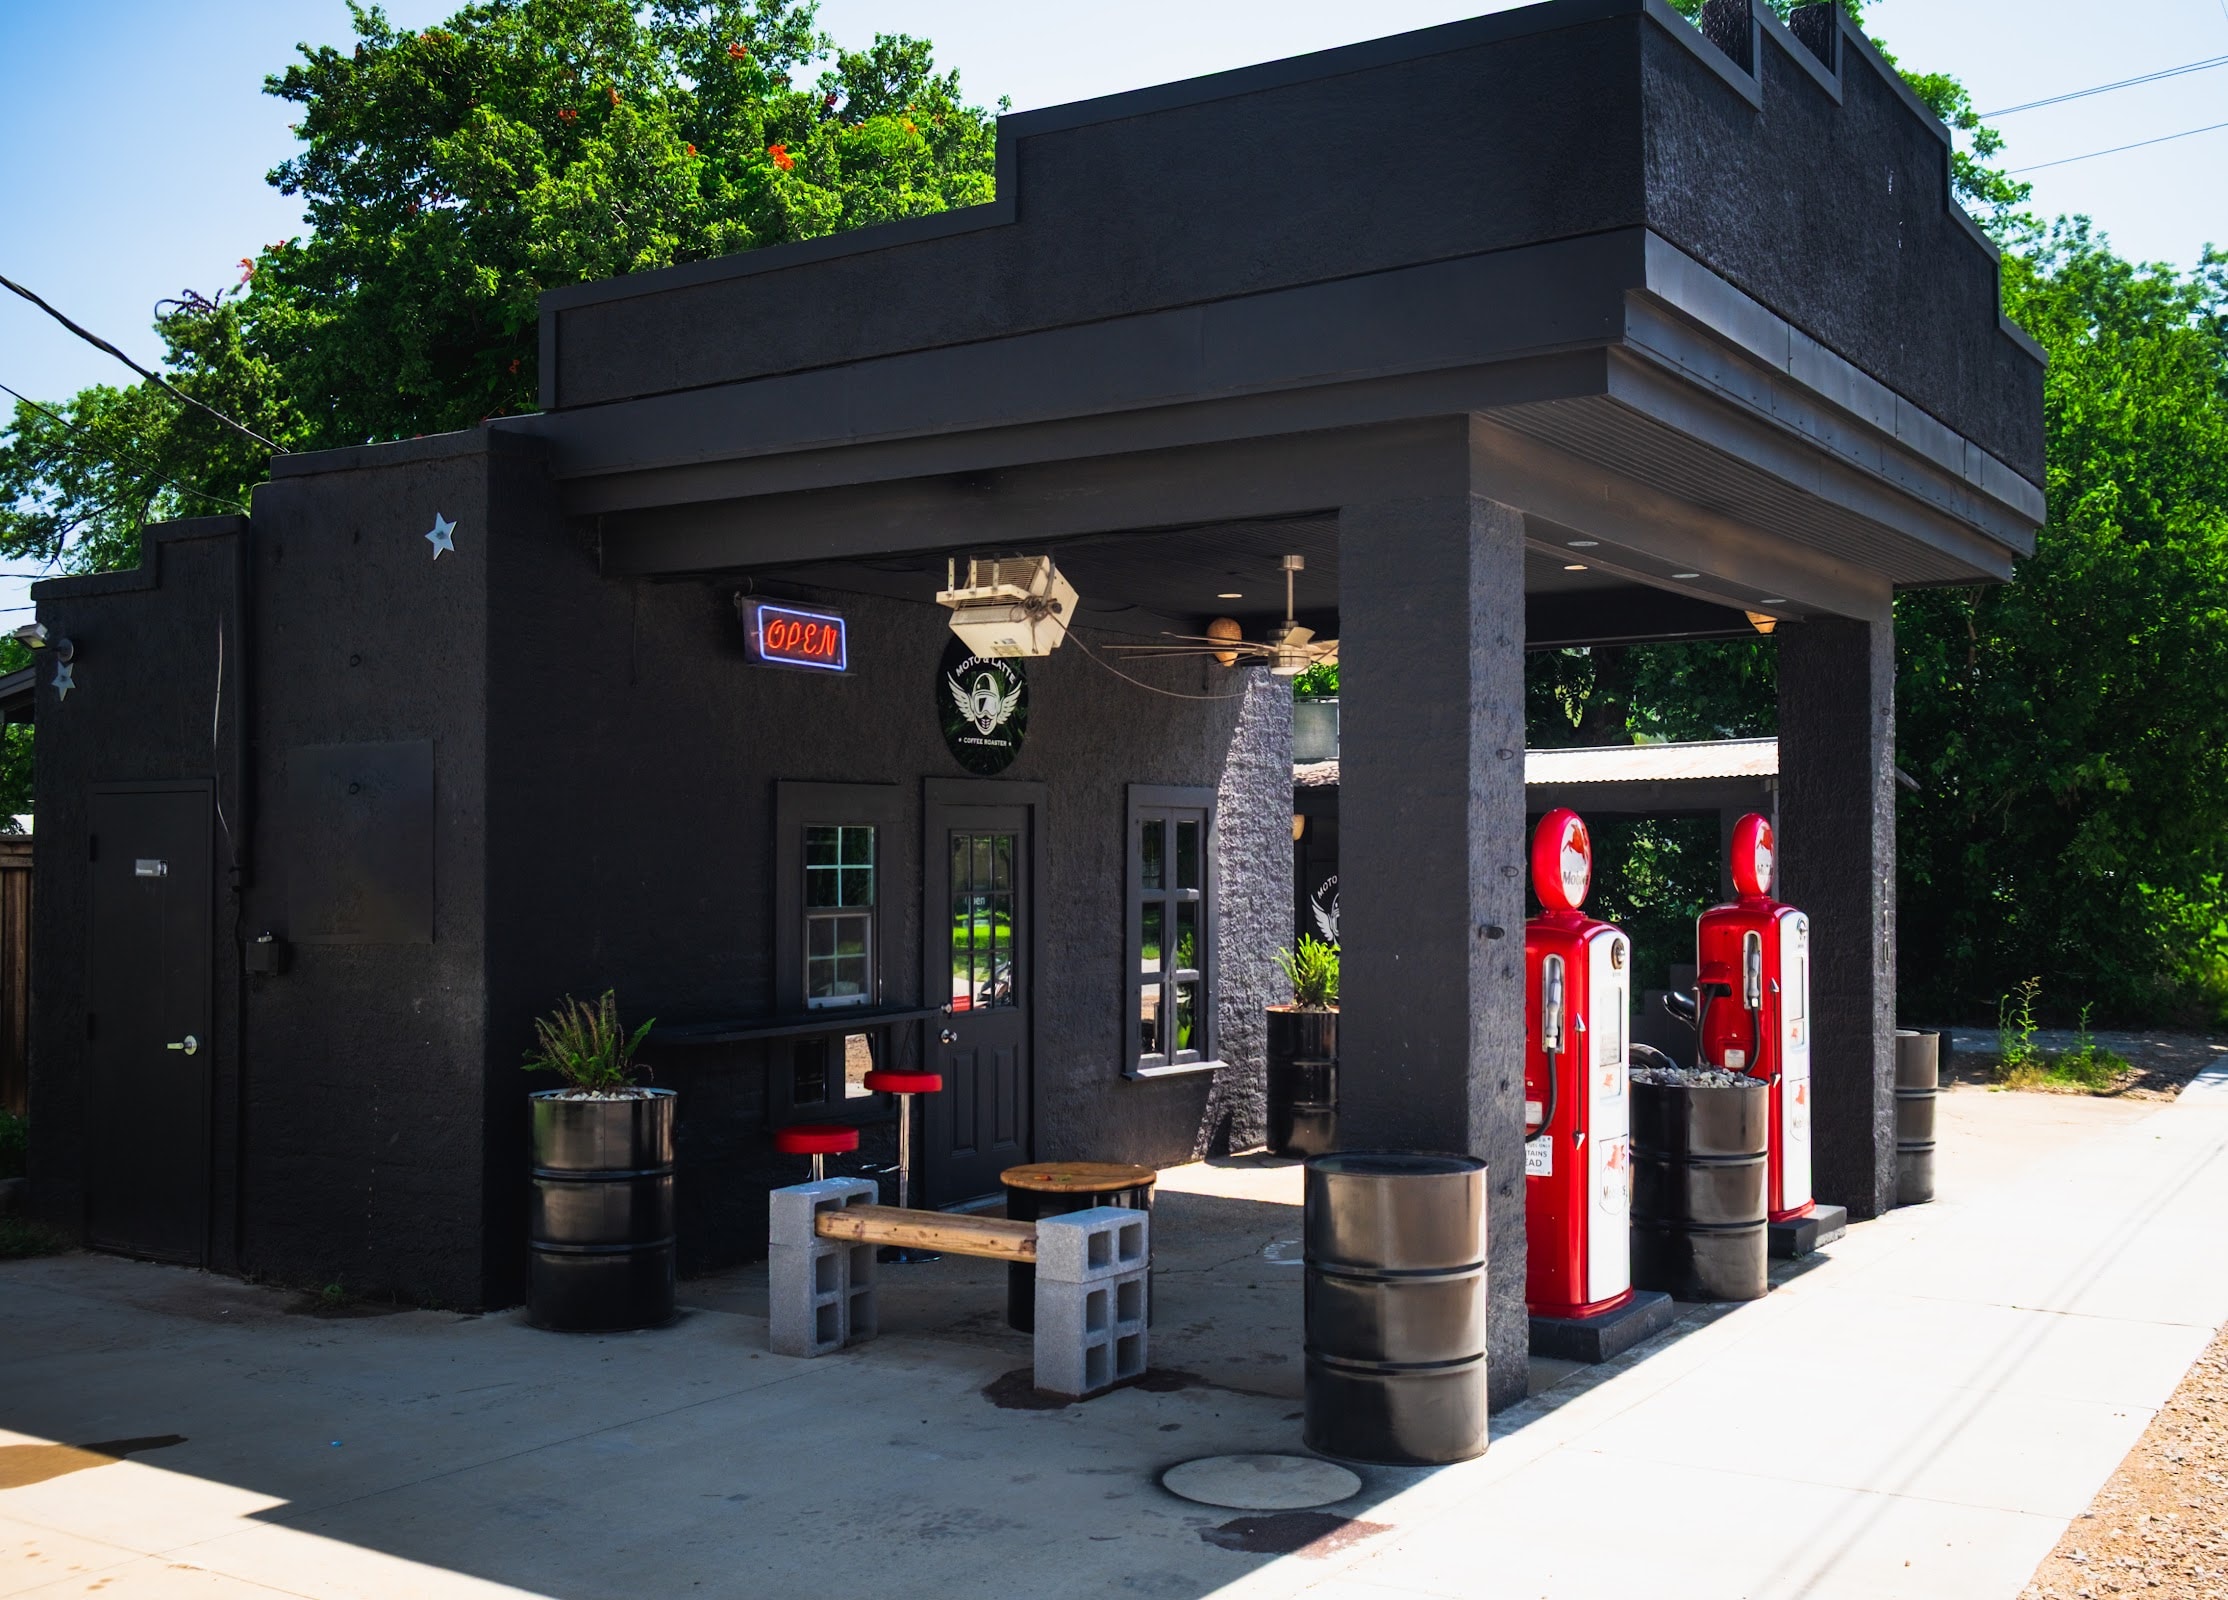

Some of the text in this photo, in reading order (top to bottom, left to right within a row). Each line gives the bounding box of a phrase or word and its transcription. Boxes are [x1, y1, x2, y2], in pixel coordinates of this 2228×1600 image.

[767, 619, 838, 656] OPEN
[955, 656, 981, 677] MOTO
[991, 656, 1017, 685] LATTE
[984, 739, 1007, 747] ROASTER
[1317, 875, 1338, 899] MOTO
